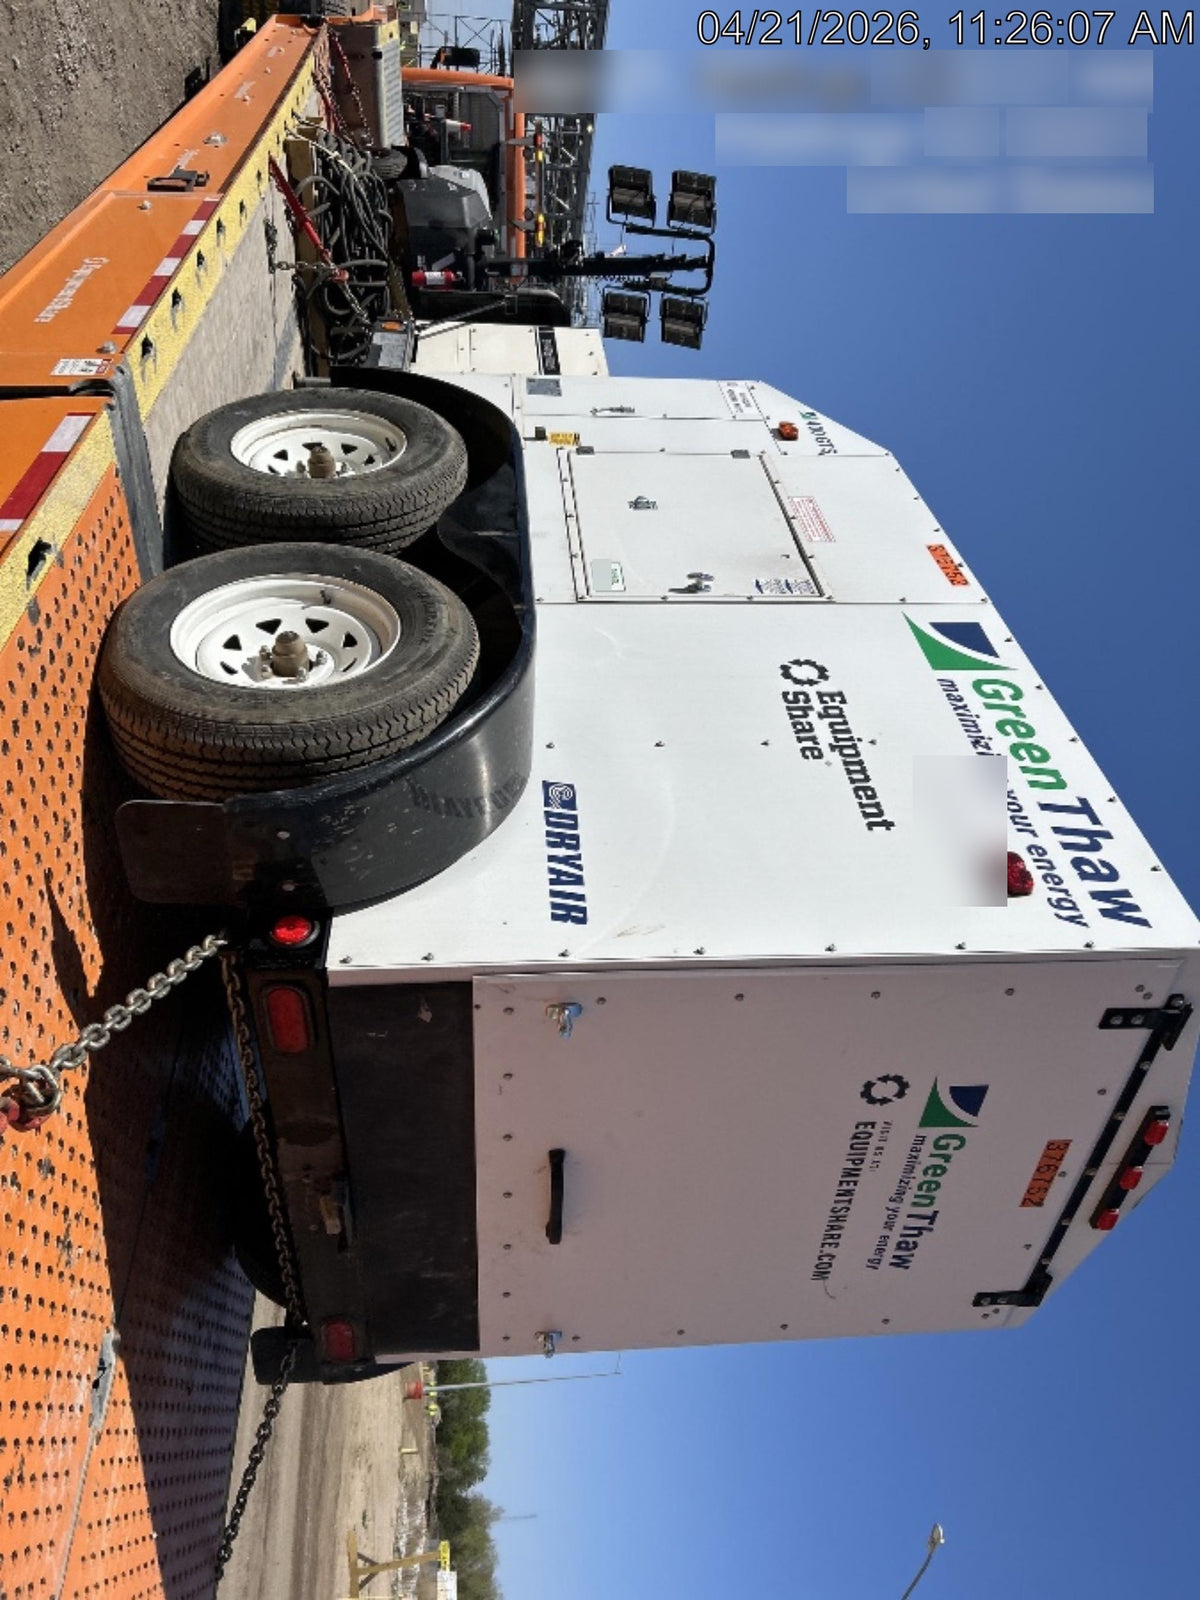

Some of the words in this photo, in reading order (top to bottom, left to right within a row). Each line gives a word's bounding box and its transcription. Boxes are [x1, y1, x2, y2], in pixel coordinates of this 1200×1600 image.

[781, 690, 825, 762] Share
[815, 690, 896, 832] Equipment
[543, 810, 588, 925] DRYAIR
[1025, 842, 1090, 929] energy
[810, 1120, 878, 1281] EQUIPMENTSHARE.COM
[887, 1134, 927, 1205] maximizing
[1019, 1140, 1072, 1208] 376752
[865, 1234, 891, 1271] energy
[882, 1205, 901, 1232] your
